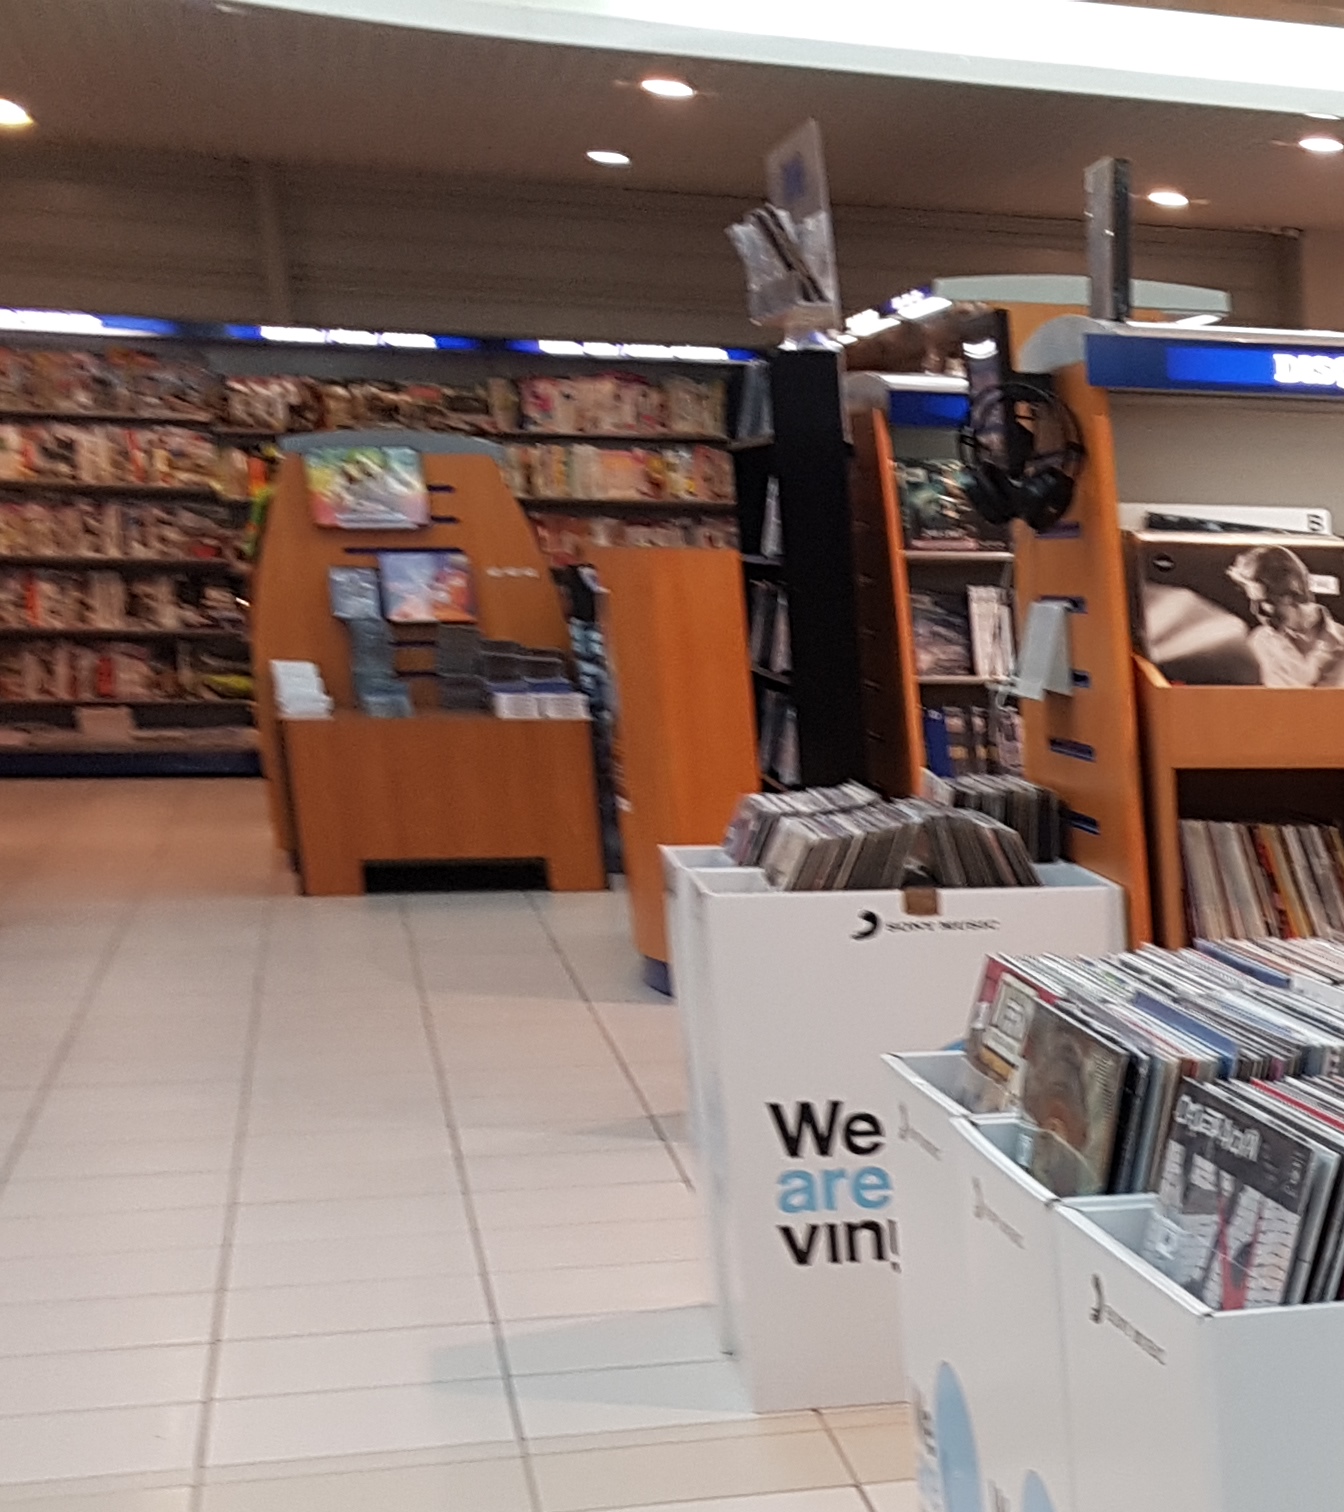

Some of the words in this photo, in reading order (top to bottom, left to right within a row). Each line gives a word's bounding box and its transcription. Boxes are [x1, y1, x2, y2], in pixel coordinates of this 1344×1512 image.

[765, 1100, 886, 1160] We
[776, 1165, 893, 1213] are
[778, 1216, 902, 1273] vin
